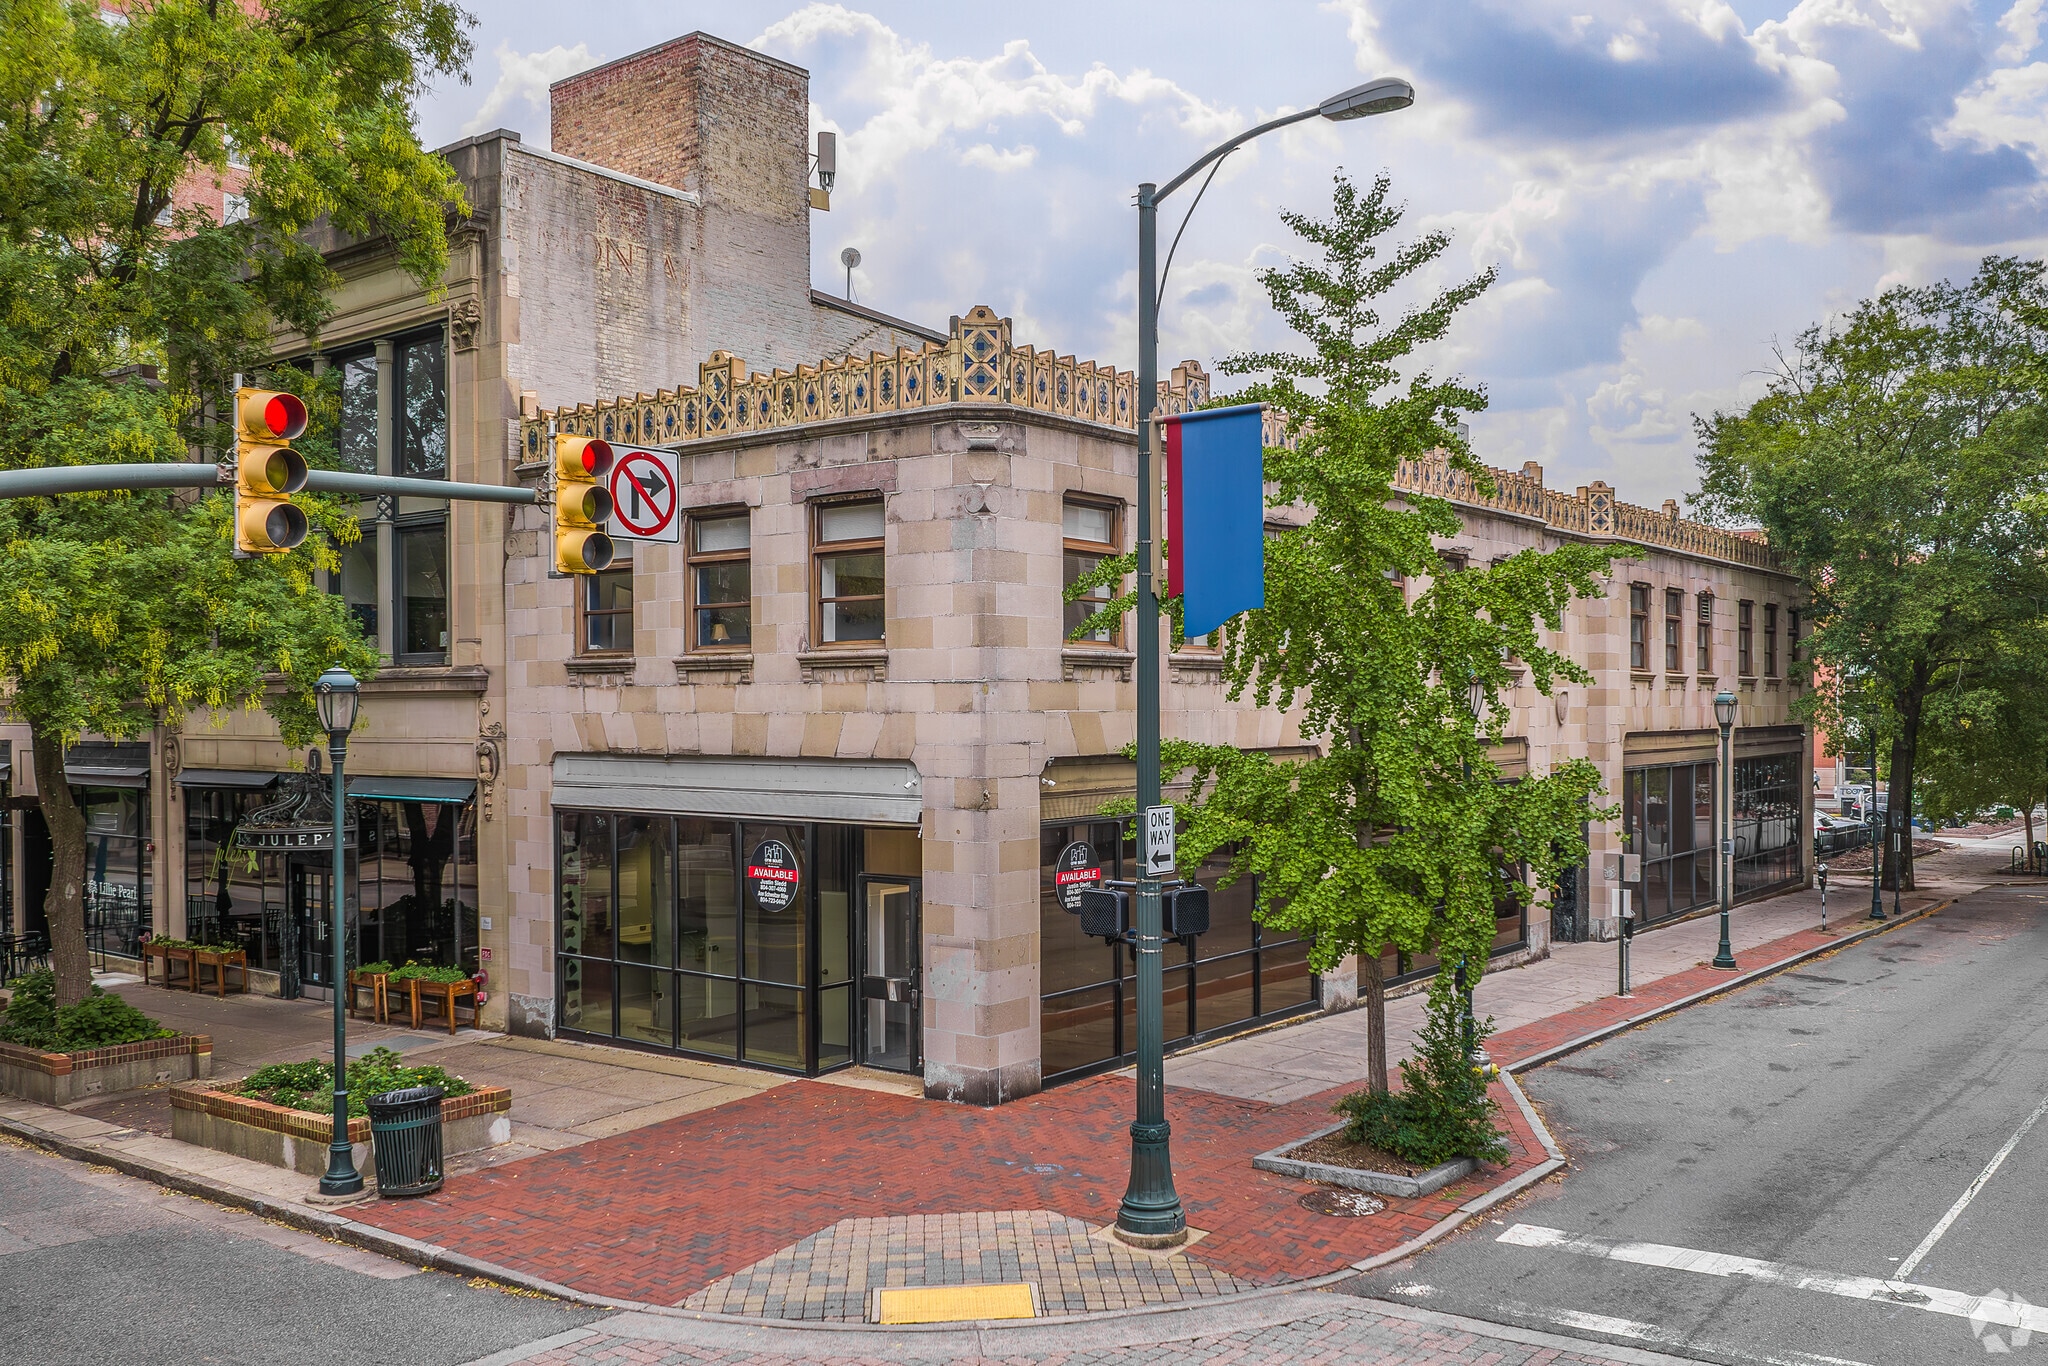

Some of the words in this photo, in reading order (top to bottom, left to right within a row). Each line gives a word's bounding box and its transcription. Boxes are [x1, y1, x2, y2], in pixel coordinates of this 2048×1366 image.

[1151, 812, 1170, 827] ONE
[259, 833, 345, 846] JULEP'
[1150, 830, 1170, 845] WAY
[754, 868, 793, 880] AVAILABLE
[1061, 870, 1096, 883] AVAILABLE
[99, 882, 117, 897] Lillie
[118, 884, 138, 900] Pearl
